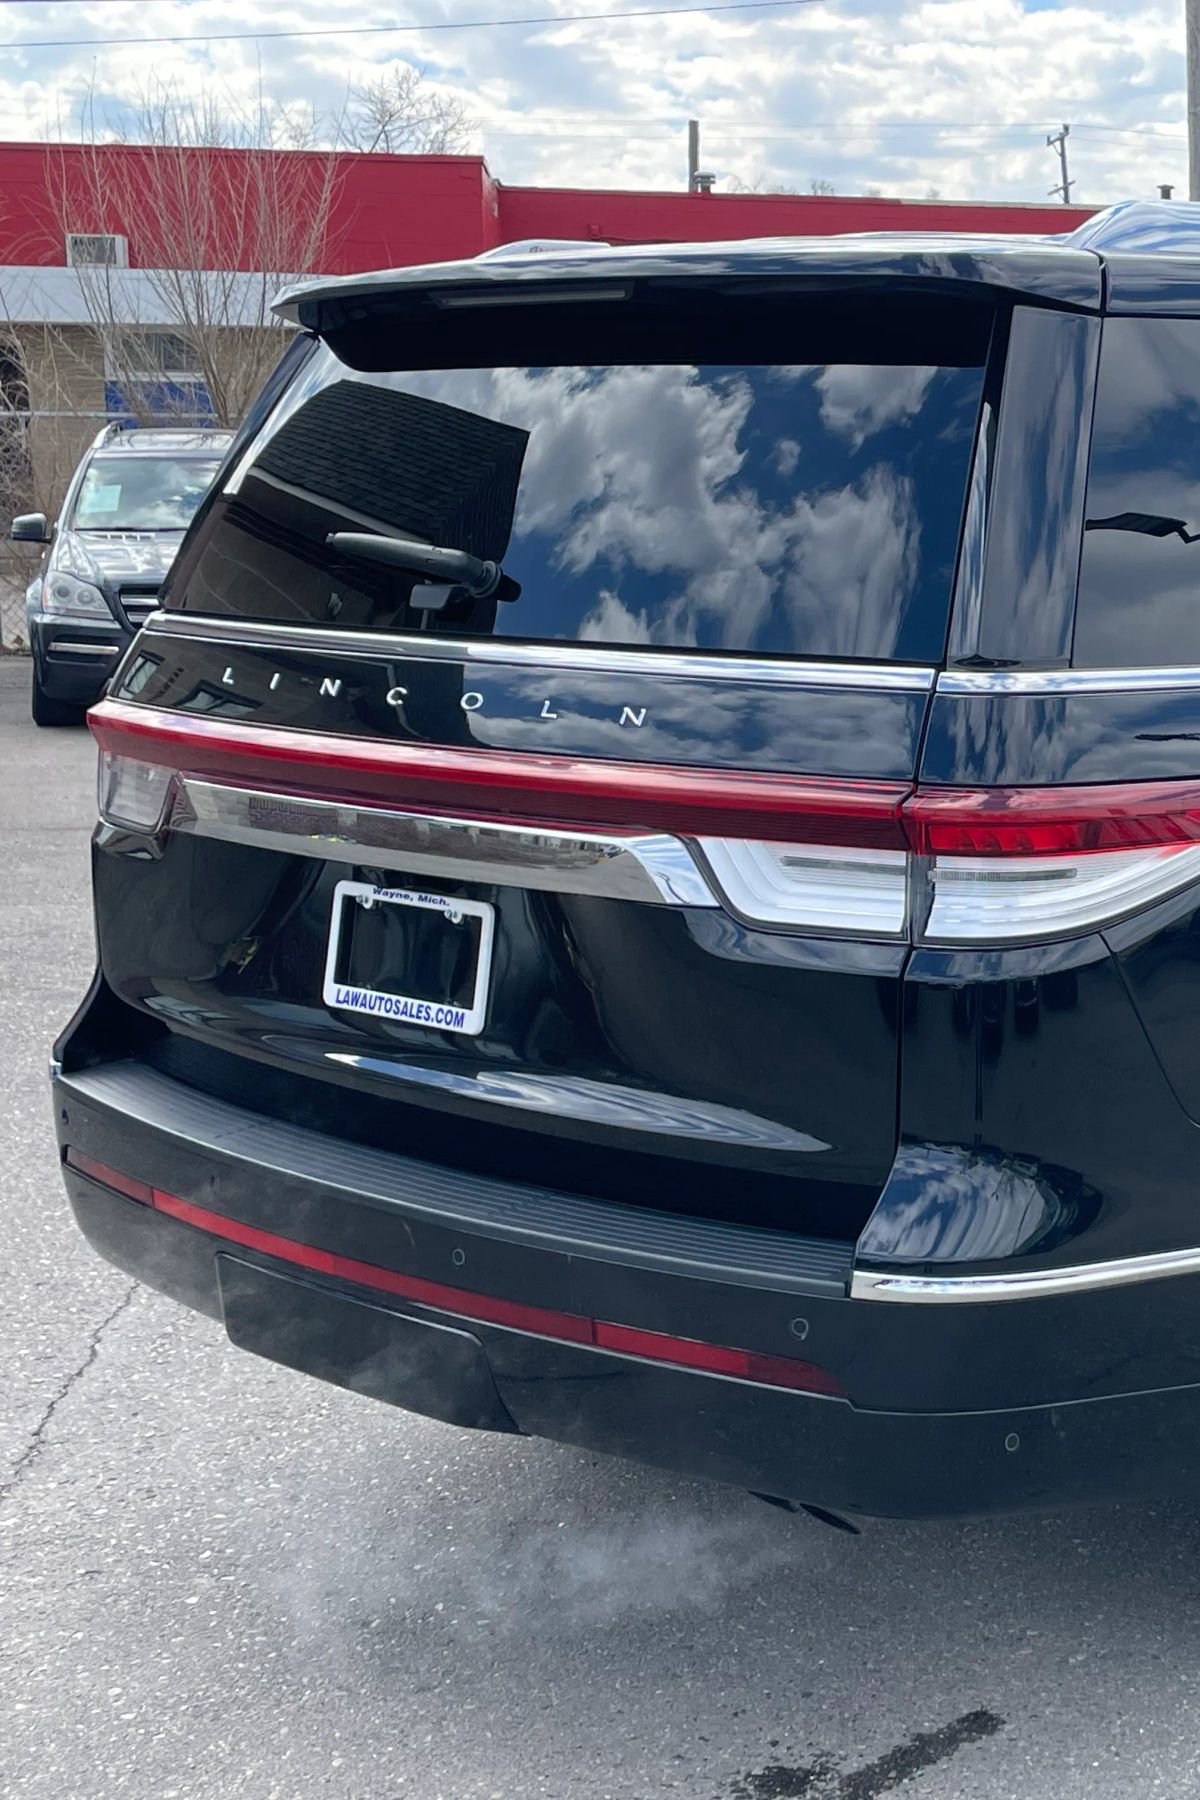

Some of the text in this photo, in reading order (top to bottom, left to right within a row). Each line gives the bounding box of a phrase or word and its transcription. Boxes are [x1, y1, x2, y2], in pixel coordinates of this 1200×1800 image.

[222, 666, 647, 727] LINCOLN
[372, 887, 451, 907] Wayne, Mich.
[335, 988, 466, 1028] LAWAUTOSALES.COM
